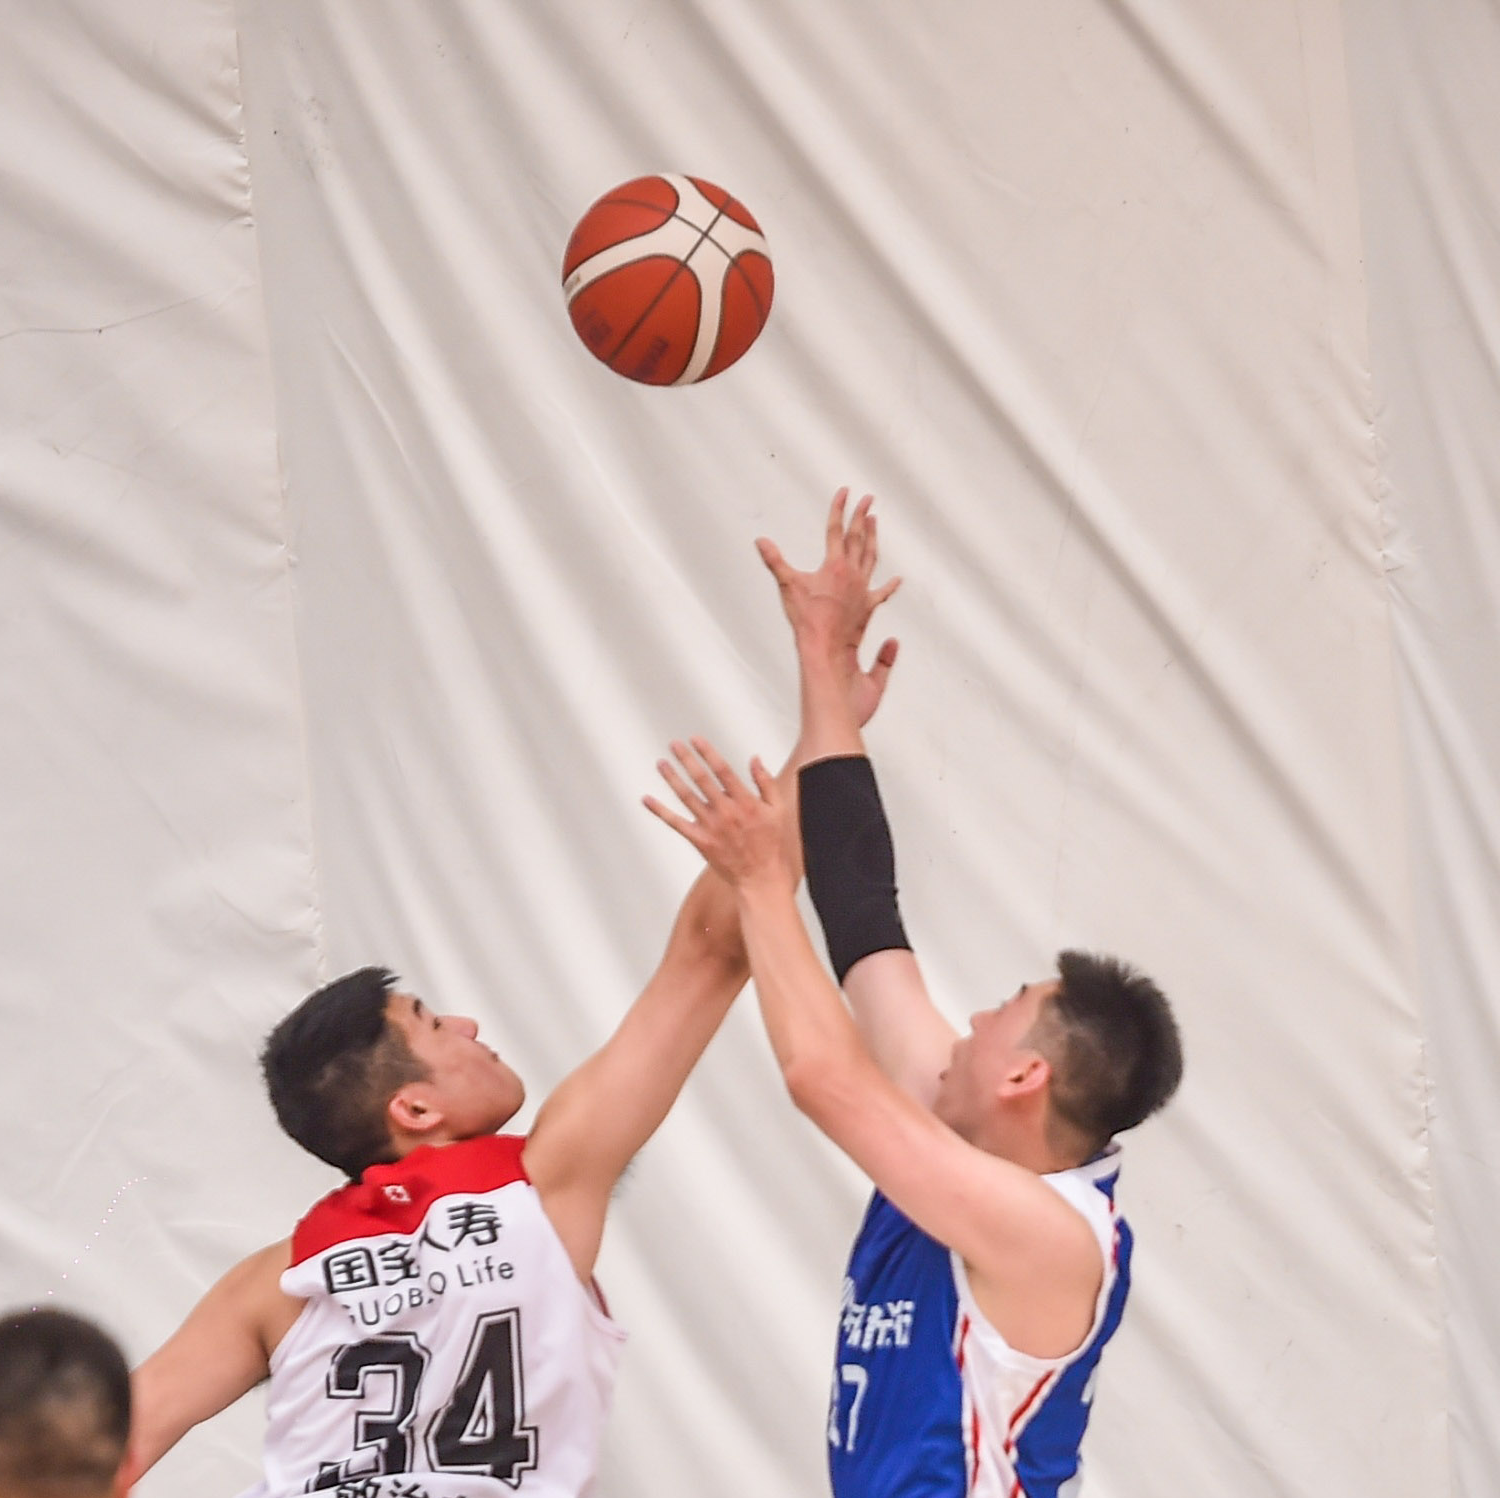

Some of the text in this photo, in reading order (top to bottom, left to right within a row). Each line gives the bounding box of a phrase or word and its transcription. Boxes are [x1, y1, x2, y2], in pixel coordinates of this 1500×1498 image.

[341, 1254, 515, 1327] UOBO Life
[306, 1307, 539, 1493] 34
[827, 1363, 868, 1453] 7
